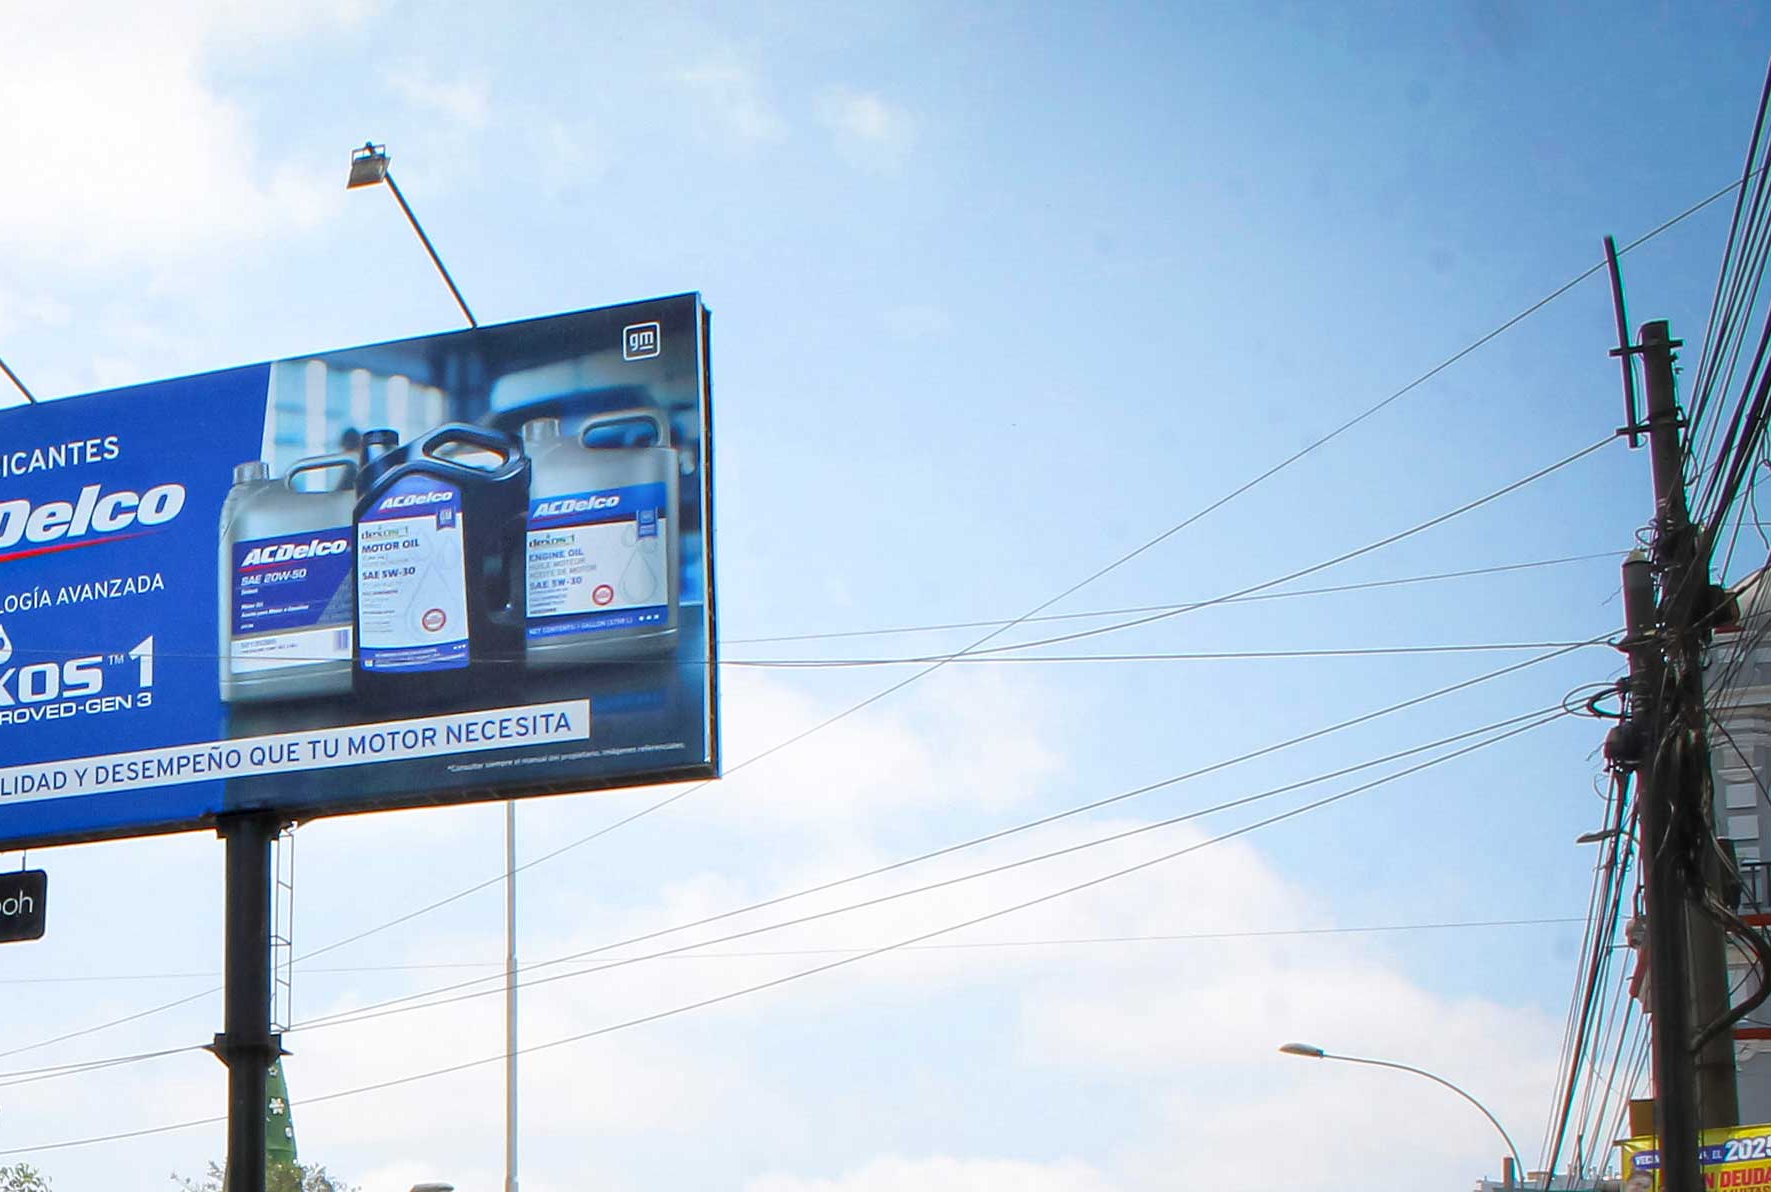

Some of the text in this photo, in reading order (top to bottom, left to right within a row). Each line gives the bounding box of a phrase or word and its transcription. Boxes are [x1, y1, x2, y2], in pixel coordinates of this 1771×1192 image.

[629, 328, 655, 351] gm
[379, 489, 453, 510] ACDelco
[532, 495, 620, 518] ACDelco
[241, 538, 348, 567] ACDelco
[362, 538, 420, 553] MOTOR OIL
[56, 572, 165, 606] AVANZADA
[241, 574, 262, 586] SAE
[128, 635, 154, 689] 1
[136, 692, 152, 708] 3
[75, 768, 89, 787] Y
[94, 744, 242, 786] DESEMPEÑO
[248, 741, 301, 769] QUE
[308, 738, 341, 762] TU
[347, 727, 437, 758] MOTOR
[445, 712, 573, 746] NECESITA
